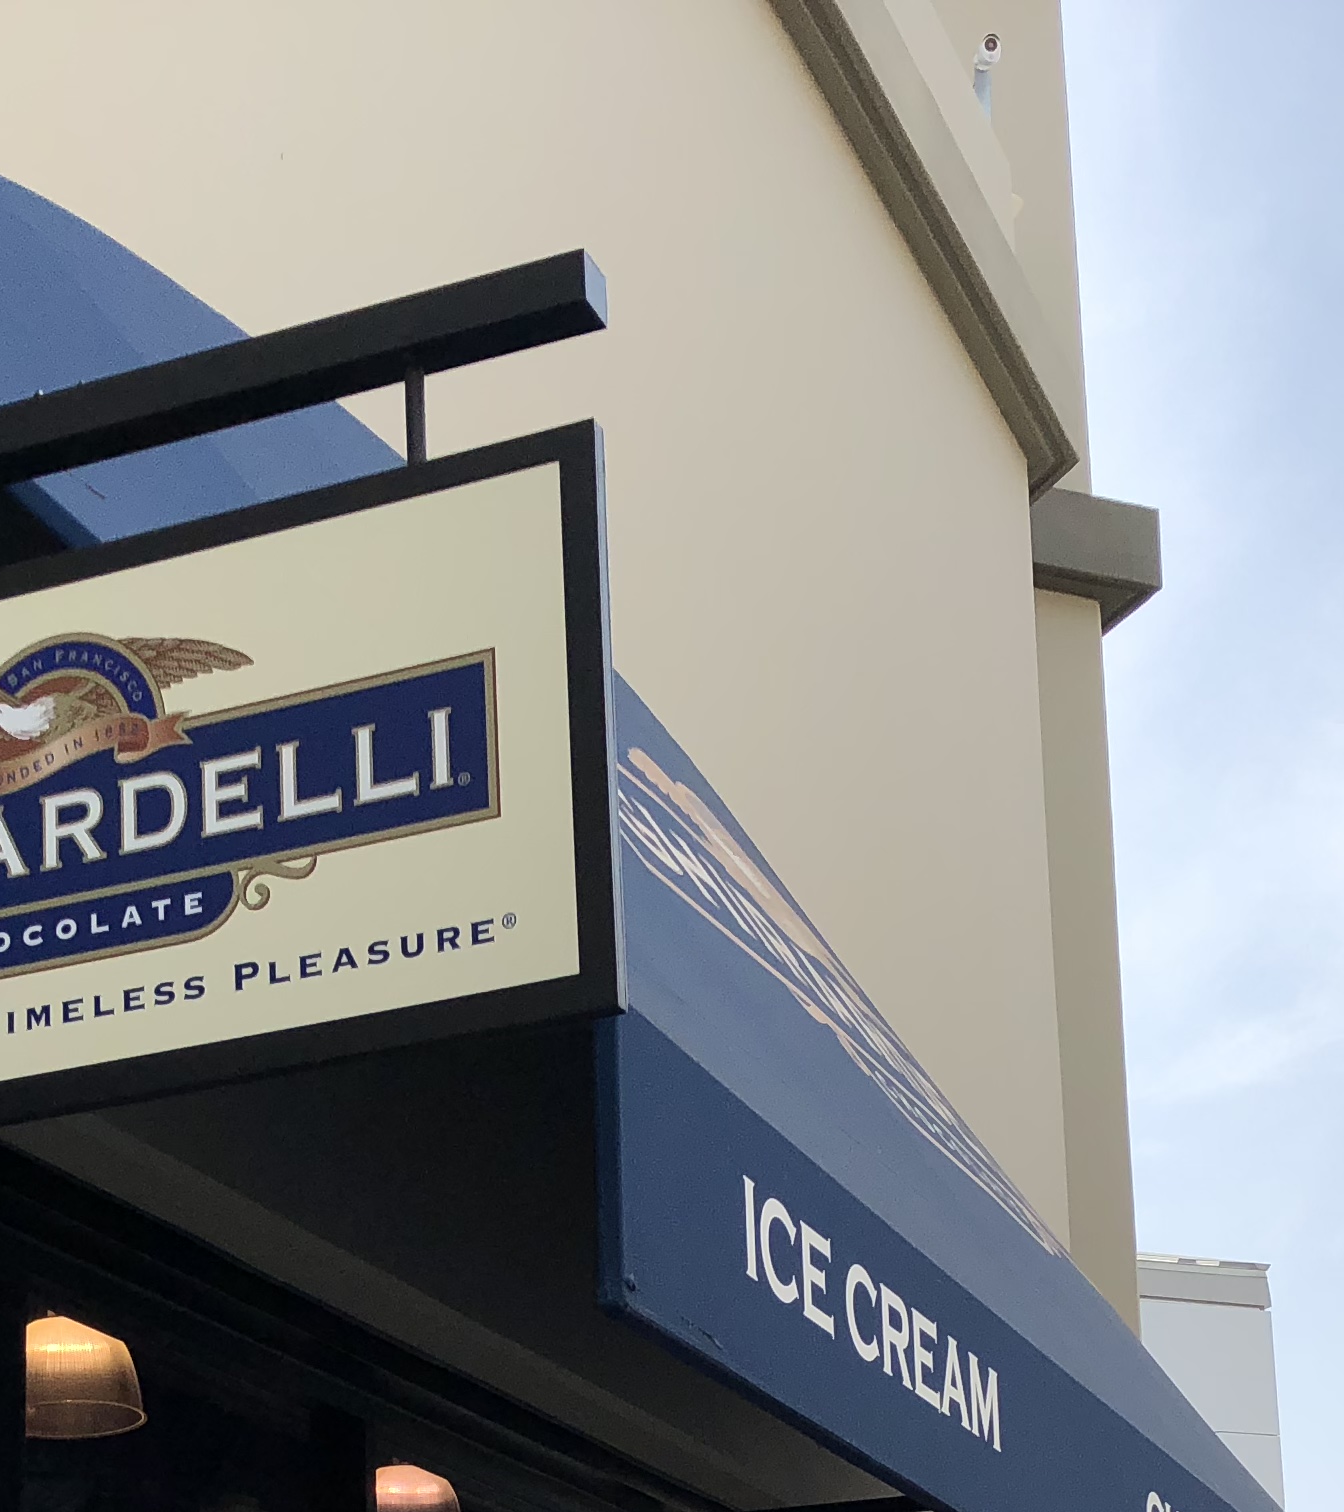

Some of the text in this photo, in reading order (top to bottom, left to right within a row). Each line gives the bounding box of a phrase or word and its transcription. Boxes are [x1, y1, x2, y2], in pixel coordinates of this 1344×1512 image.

[7, 649, 143, 702] SAN FRANCISCO
[64, 736, 84, 755] IN
[743, 1174, 1002, 1452] ICE CREAM
